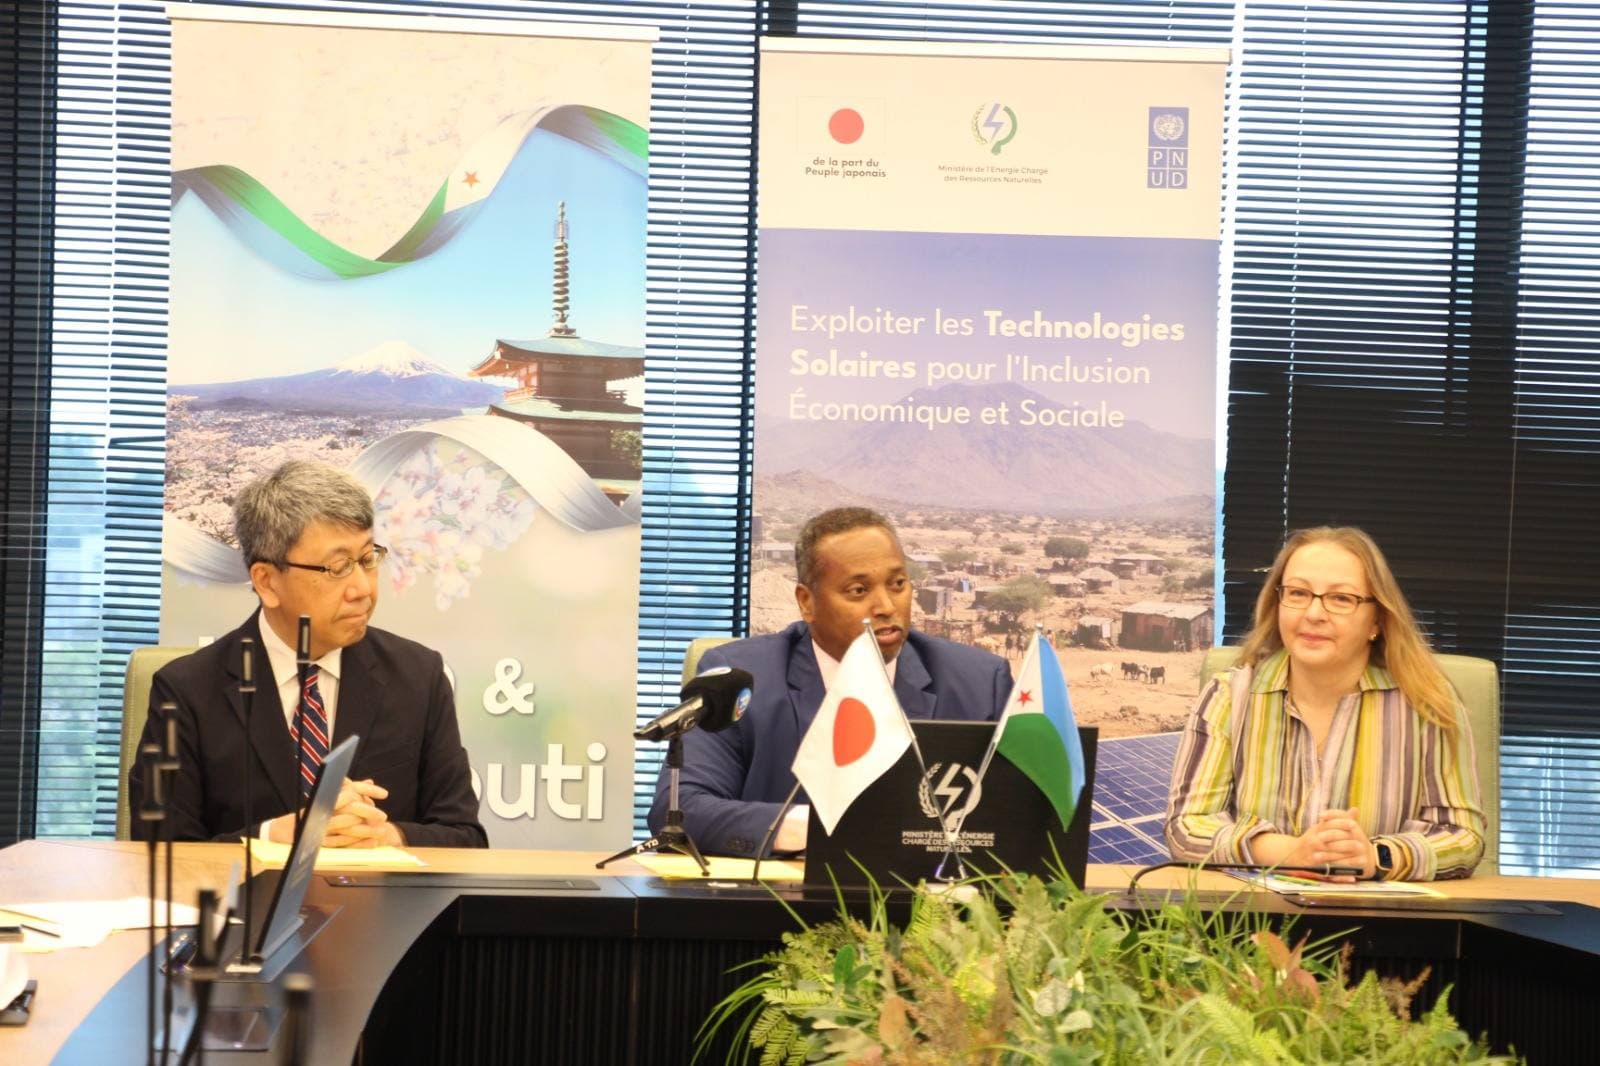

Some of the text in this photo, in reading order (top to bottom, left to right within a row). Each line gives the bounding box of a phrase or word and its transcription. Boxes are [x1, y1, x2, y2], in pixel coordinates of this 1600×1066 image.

[805, 166, 887, 179] Peuple japonais
[812, 157, 879, 168] de la part du
[975, 165, 984, 173] de
[959, 175, 1002, 183] Ressources
[1003, 176, 1043, 184] Naturelles
[790, 305, 1185, 347] Exploiter les Technologies
[789, 348, 1151, 385] Solaires pour l'Inclusion
[789, 387, 1125, 431] Économique et Sociale
[482, 657, 534, 715] &
